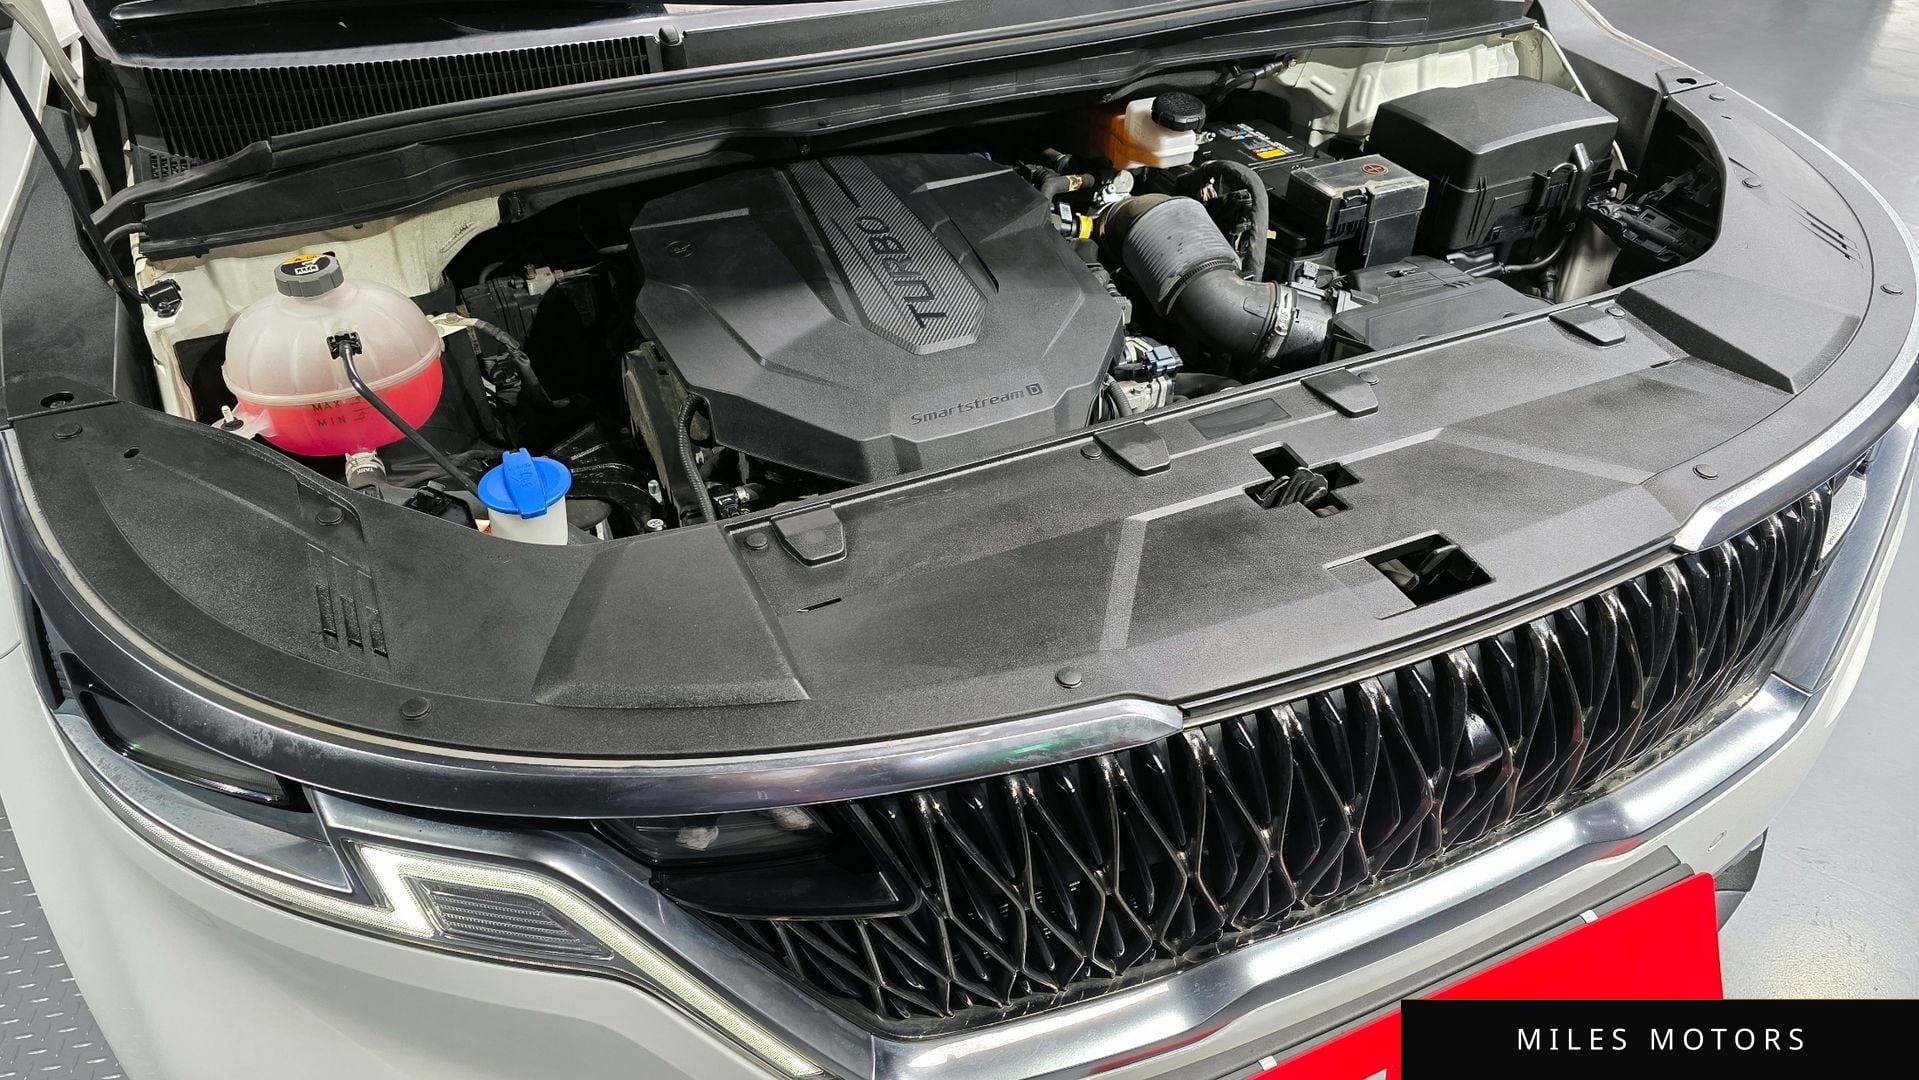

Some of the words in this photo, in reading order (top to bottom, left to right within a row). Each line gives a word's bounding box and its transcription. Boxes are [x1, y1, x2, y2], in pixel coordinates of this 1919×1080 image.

[854, 215, 947, 329] TURBO
[311, 400, 341, 412] MAX
[911, 389, 1025, 425] Smartstream
[316, 415, 346, 427] MIN
